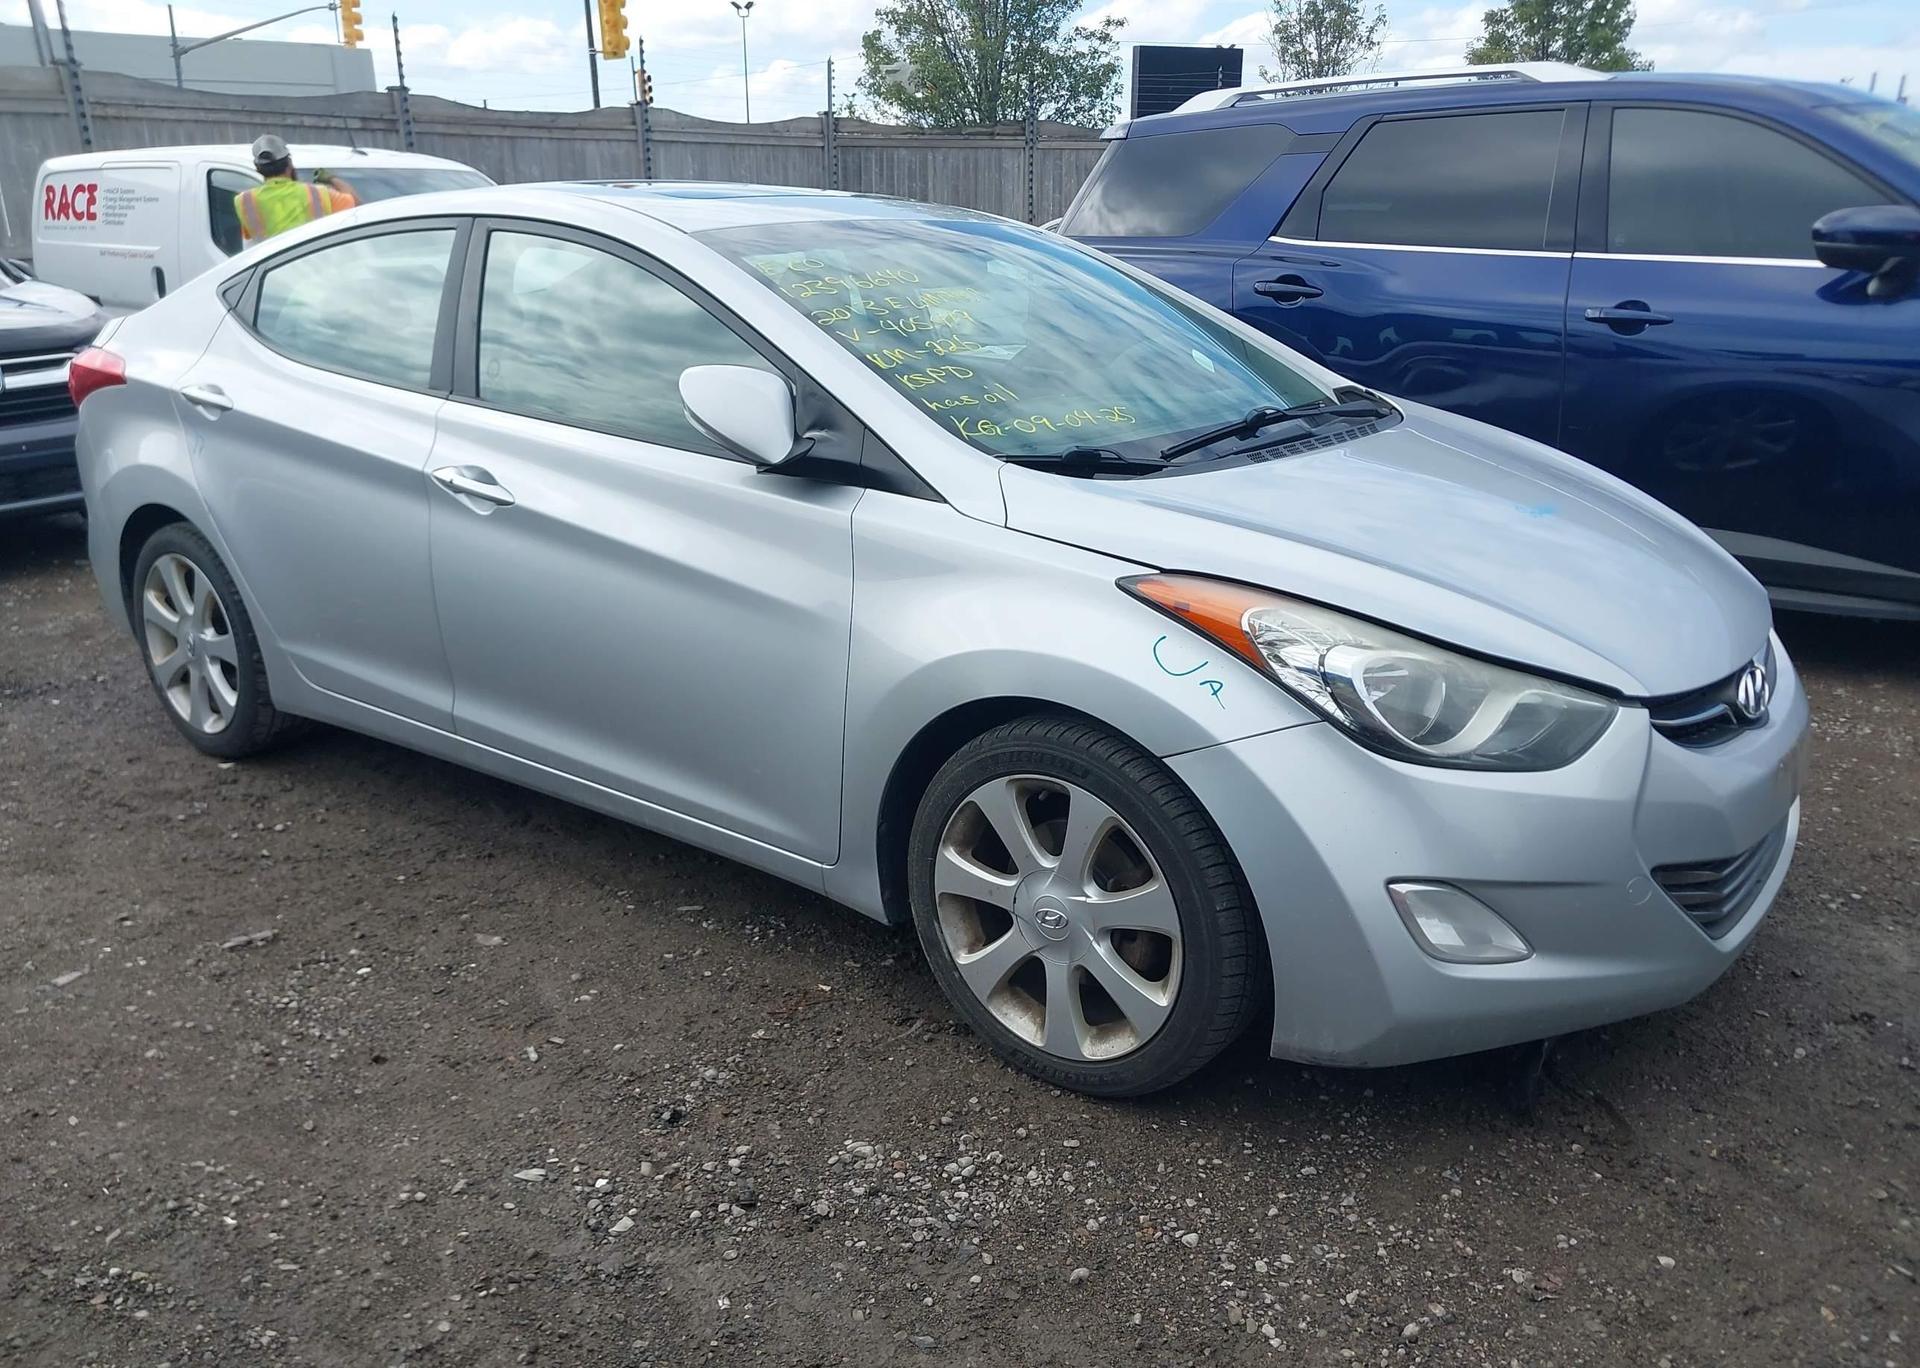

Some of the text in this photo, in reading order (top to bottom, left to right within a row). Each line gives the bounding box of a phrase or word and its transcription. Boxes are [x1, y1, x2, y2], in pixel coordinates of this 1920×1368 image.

[44, 183, 98, 222] RACE
[811, 300, 889, 326] 2013
[920, 382, 1020, 412] has oil
